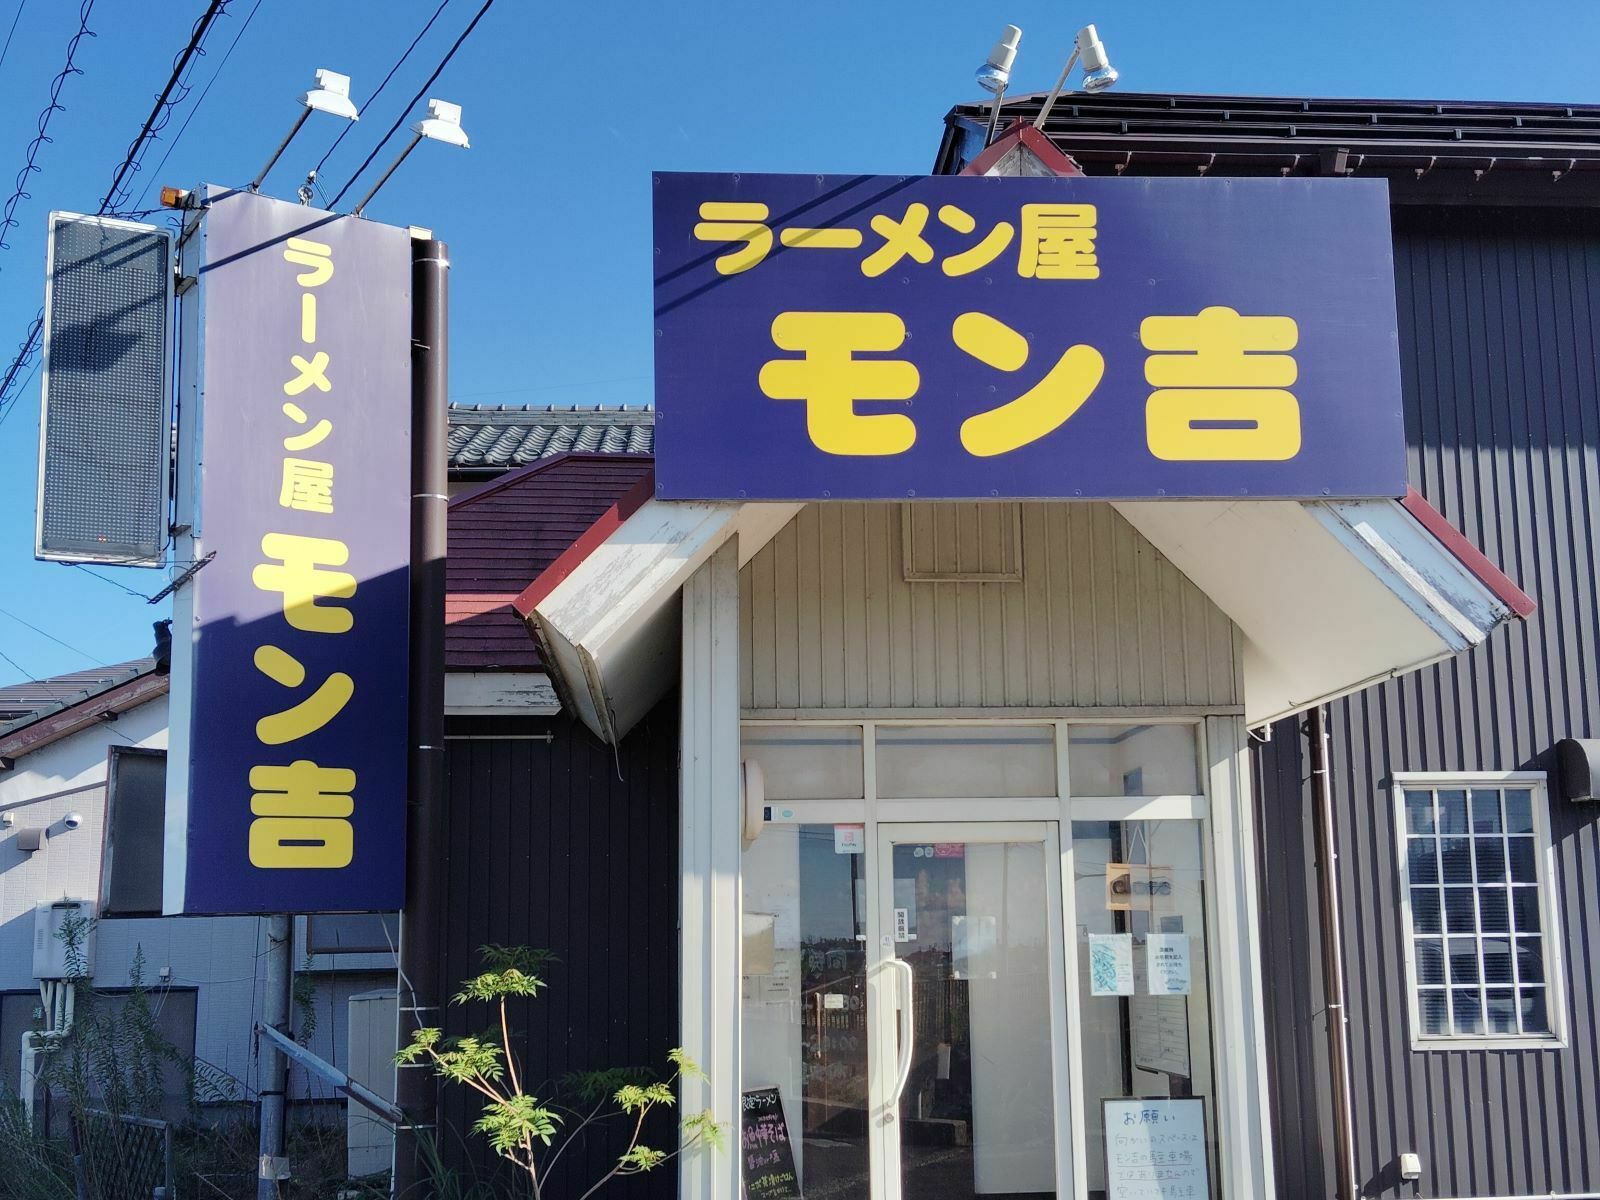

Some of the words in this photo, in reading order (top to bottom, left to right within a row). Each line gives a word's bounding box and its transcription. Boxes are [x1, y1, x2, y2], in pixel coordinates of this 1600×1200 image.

[693, 202, 1102, 280] ラーメン屋
[279, 238, 334, 514] ラーメン屋
[758, 306, 1302, 463] モン吉
[249, 532, 358, 870] モン吉
[1123, 1109, 1176, 1126] お願い
